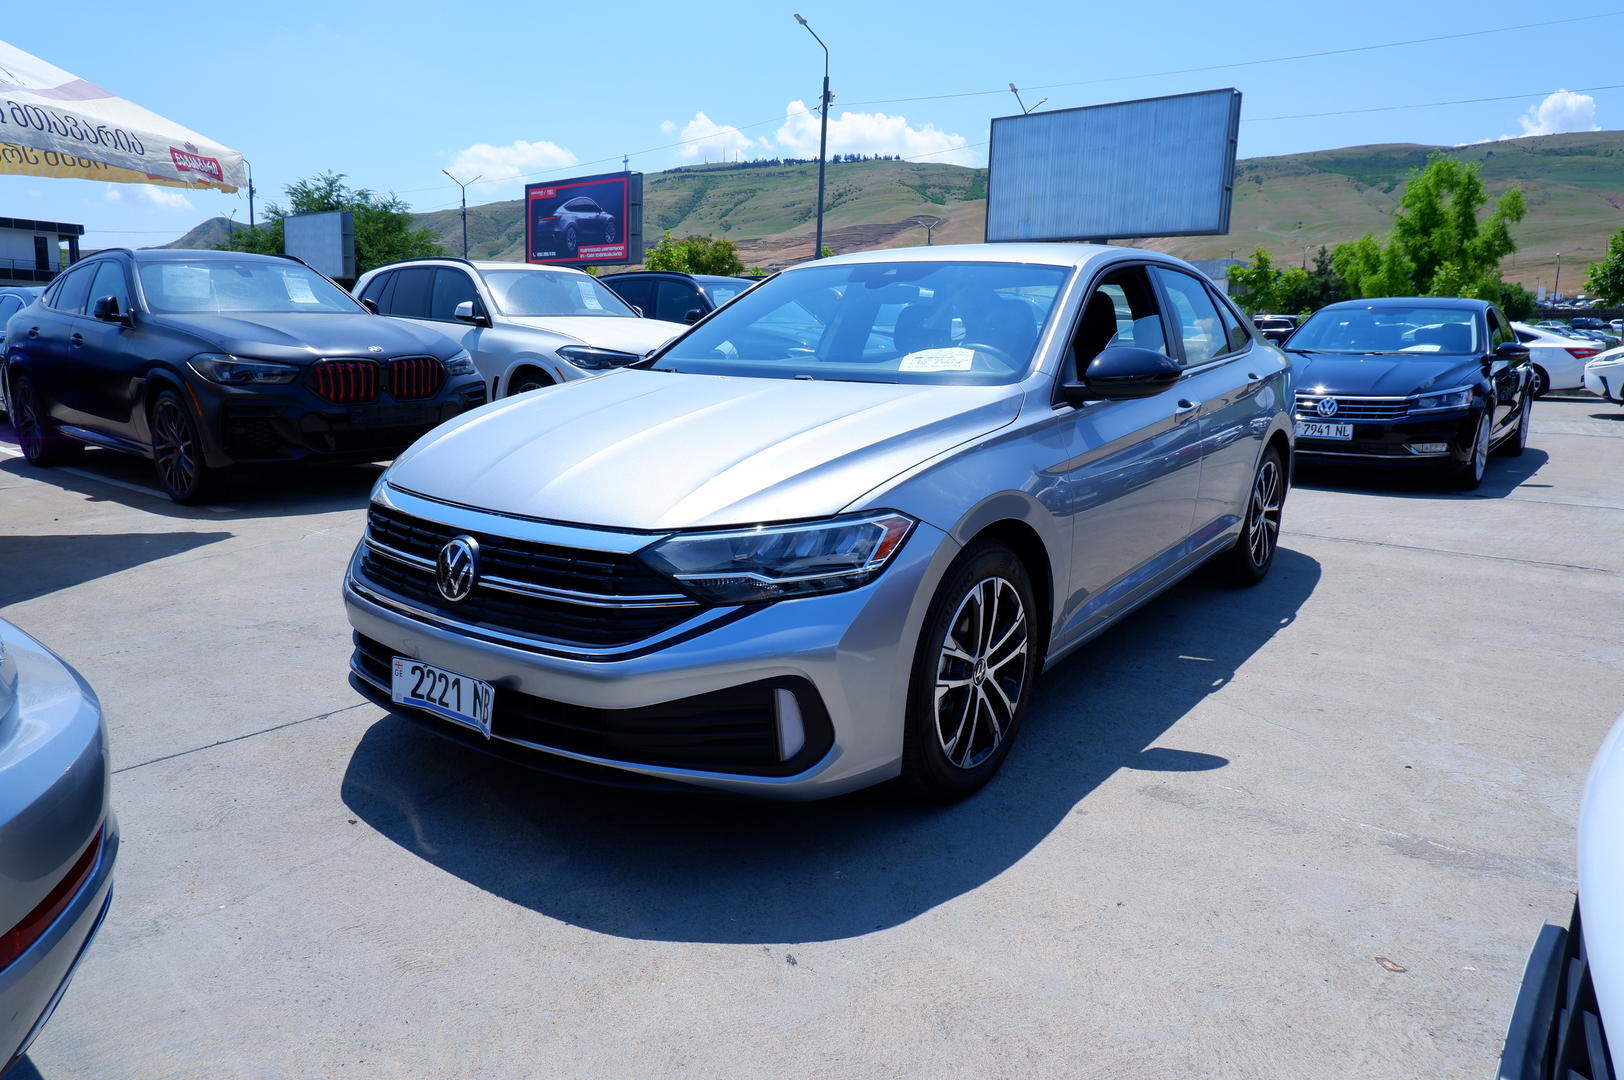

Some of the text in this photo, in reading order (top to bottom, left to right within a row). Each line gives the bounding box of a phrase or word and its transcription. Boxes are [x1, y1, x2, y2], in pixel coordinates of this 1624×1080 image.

[7, 100, 145, 156] მთავარია
[1303, 423, 1350, 437] 7941 NL
[410, 664, 491, 725] 2221 NB
